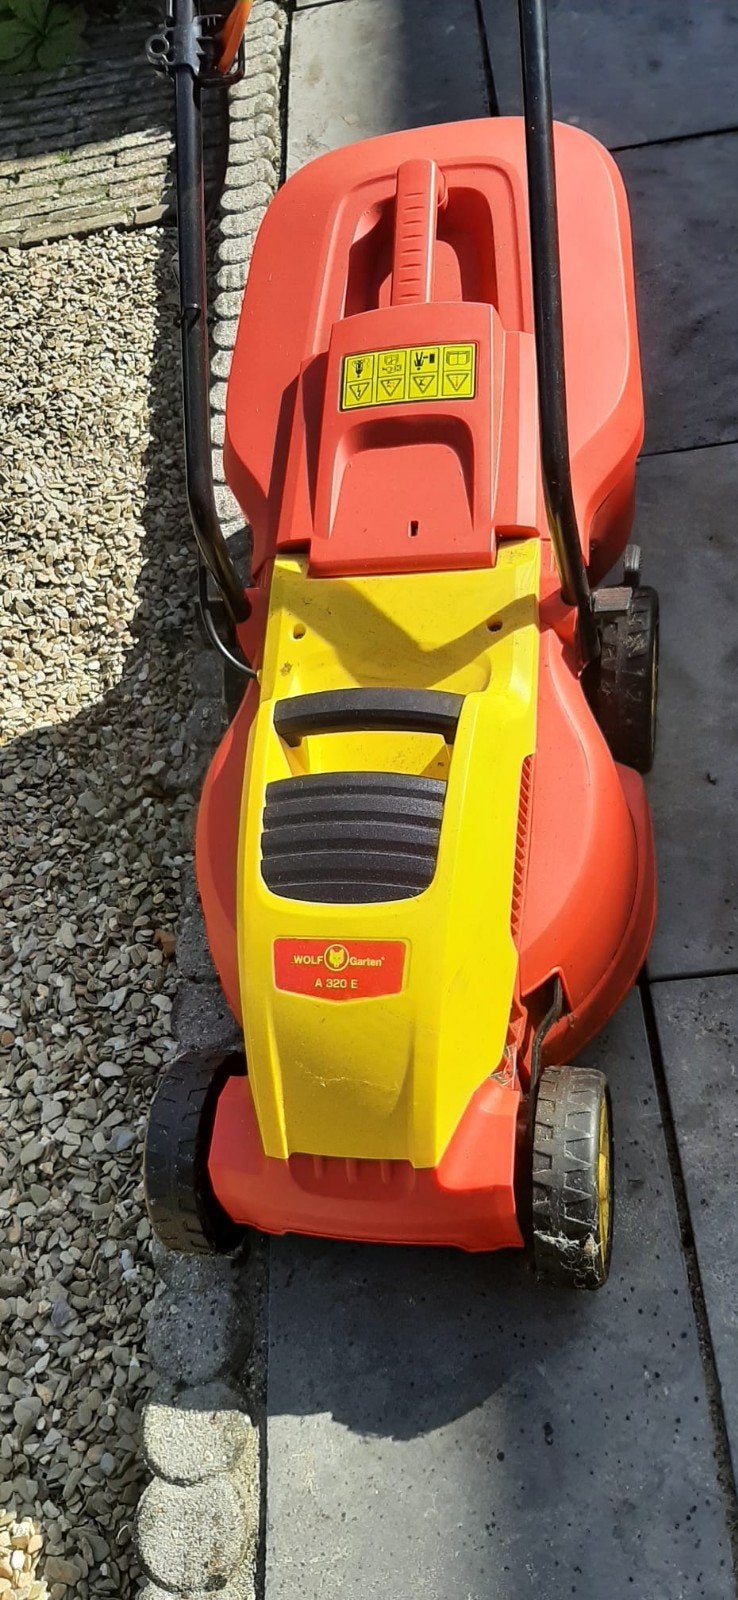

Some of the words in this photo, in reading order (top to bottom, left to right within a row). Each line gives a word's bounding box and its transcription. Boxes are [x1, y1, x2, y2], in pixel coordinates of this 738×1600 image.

[293, 955, 323, 965] WOLF
[314, 977, 323, 988] A
[325, 978, 347, 988] 320
[350, 978, 358, 989] E
